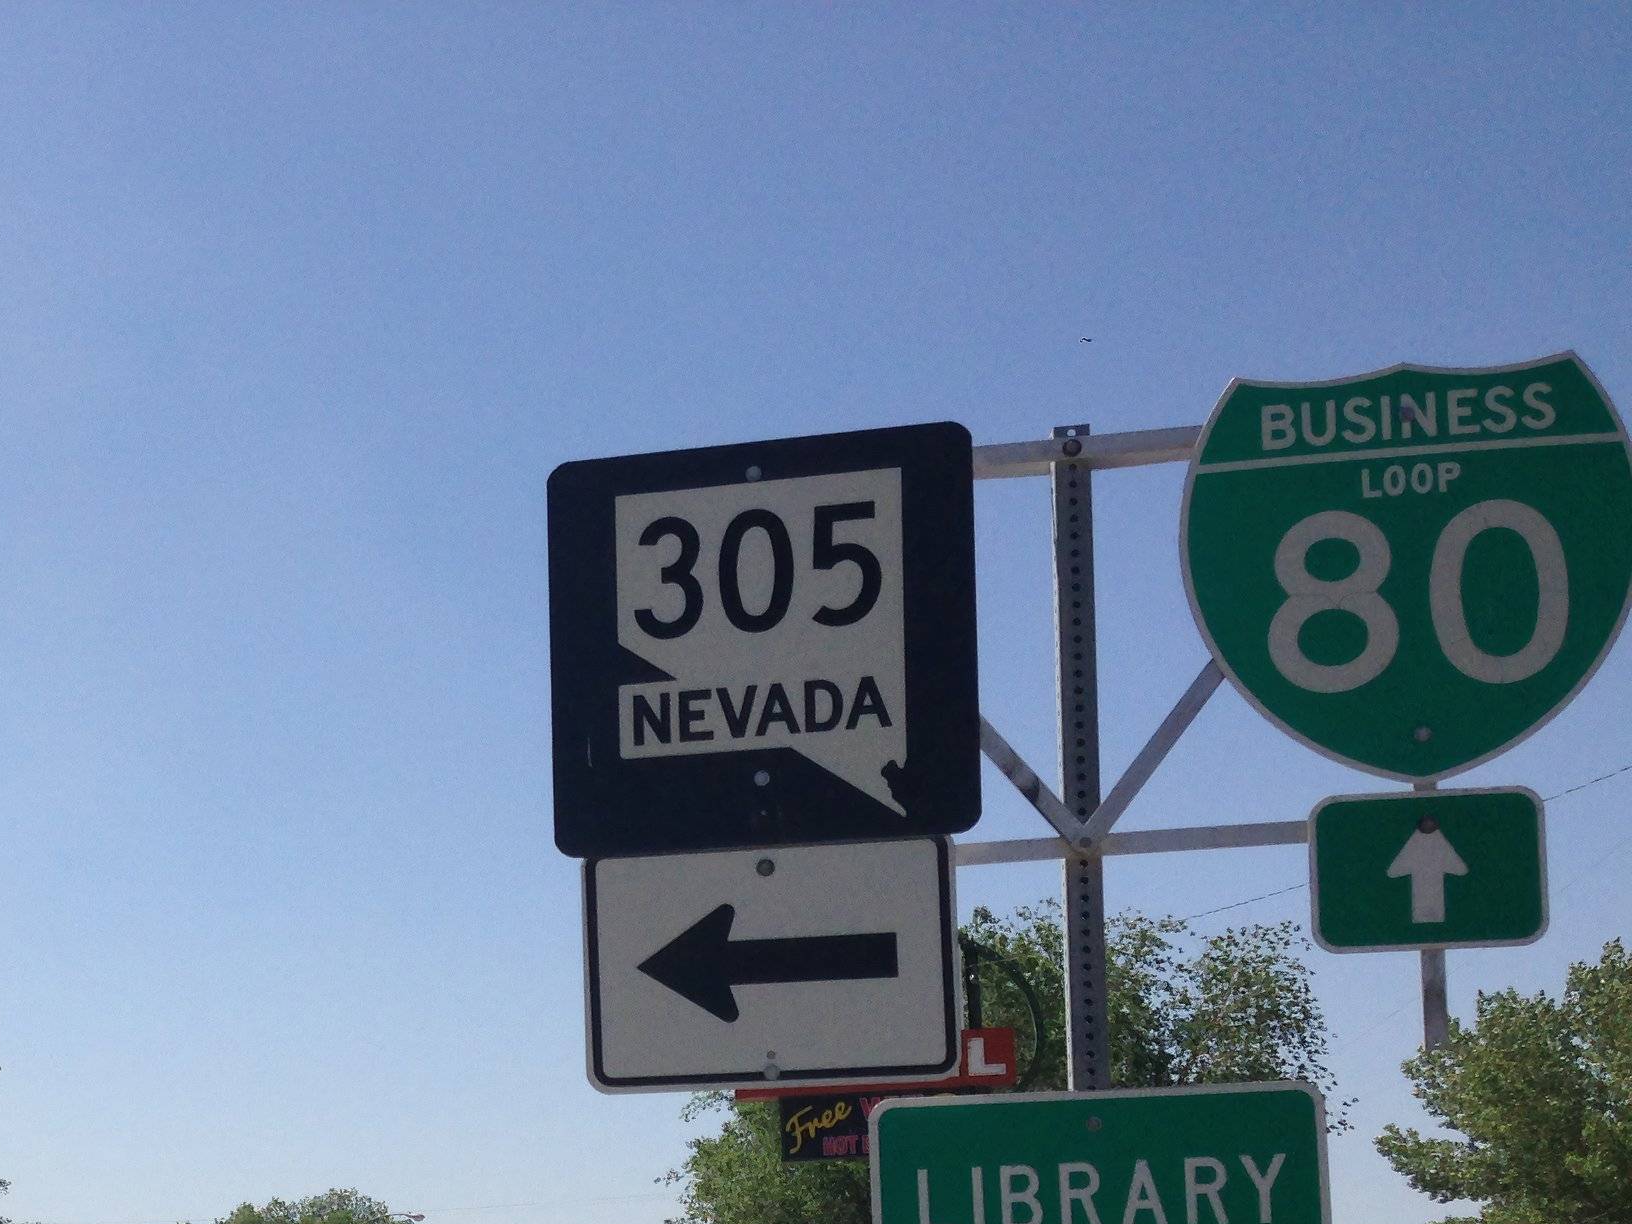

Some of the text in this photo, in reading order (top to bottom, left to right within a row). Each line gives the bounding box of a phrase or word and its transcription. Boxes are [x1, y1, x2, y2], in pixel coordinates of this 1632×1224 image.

[1261, 382, 1557, 451] BUSINESS
[1361, 462, 1462, 498] LOOP
[634, 500, 882, 639] 305
[1268, 499, 1569, 693] 80
[633, 676, 892, 746] NEVADA
[786, 1101, 853, 1154] Free
